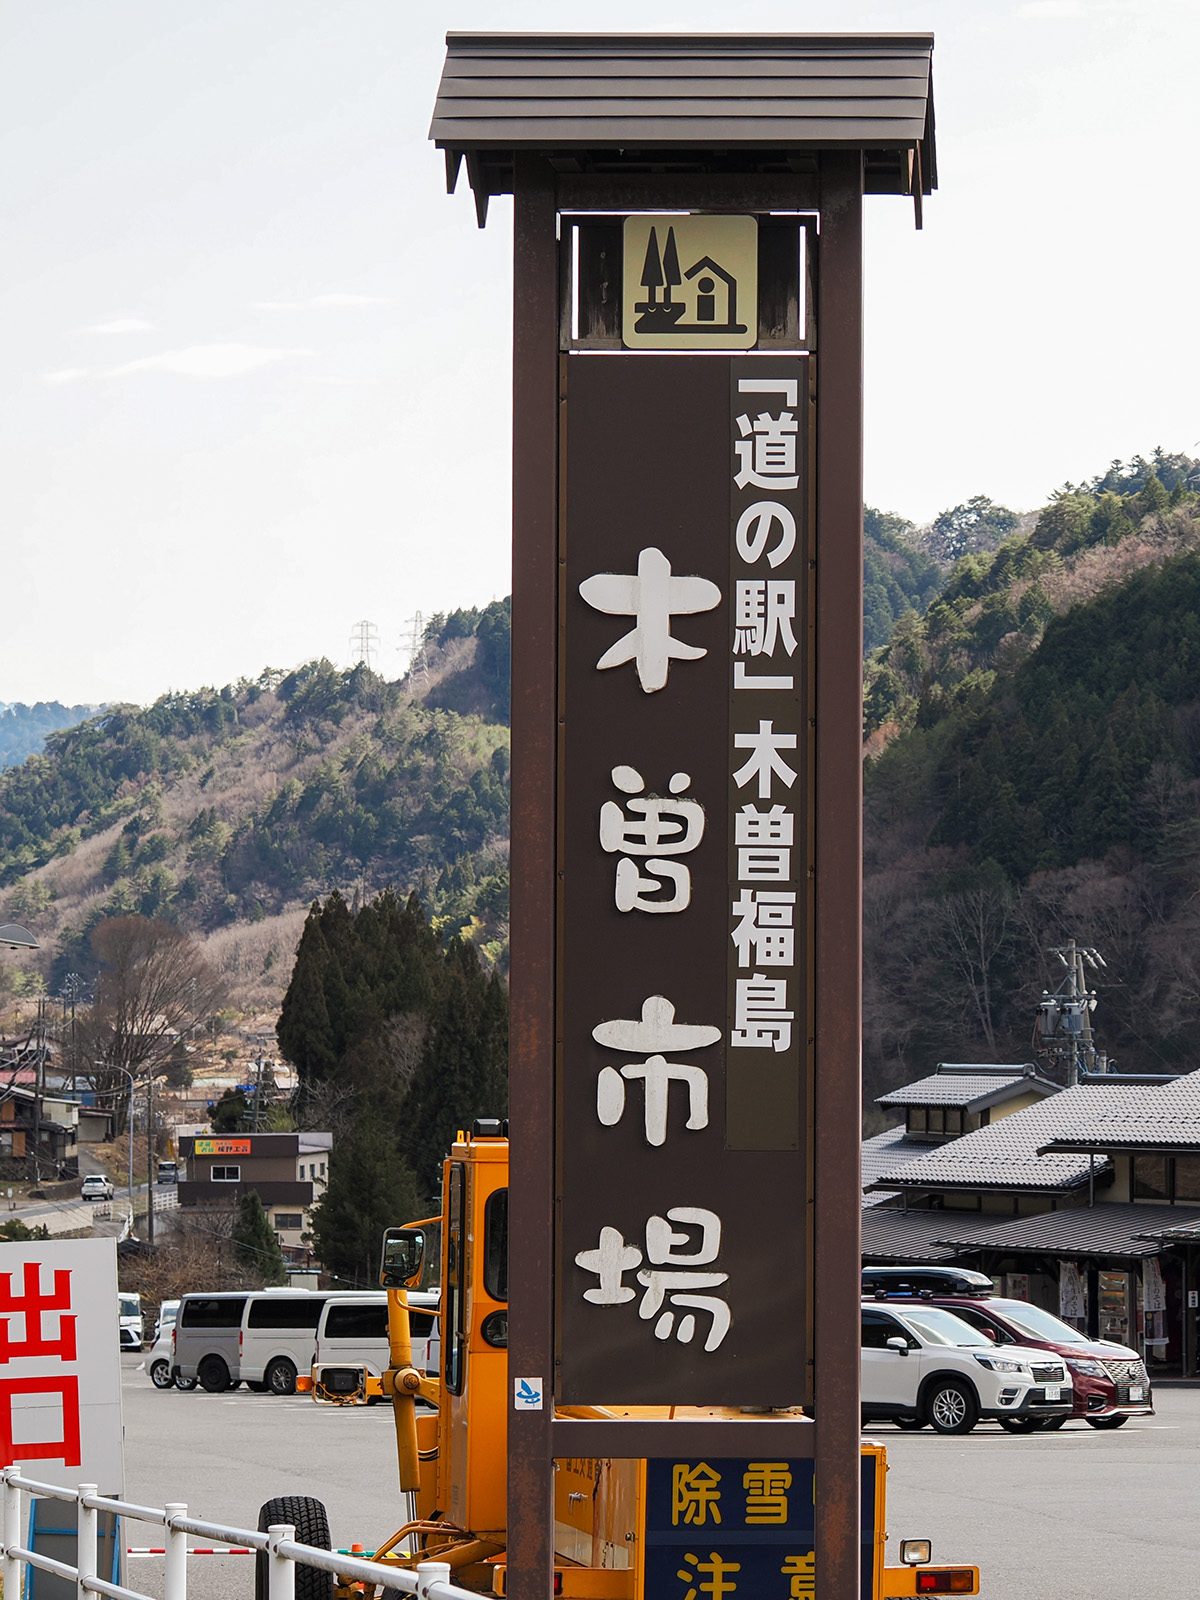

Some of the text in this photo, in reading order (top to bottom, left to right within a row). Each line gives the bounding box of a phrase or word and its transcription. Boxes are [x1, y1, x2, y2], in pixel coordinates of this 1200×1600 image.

[575, 547, 732, 1352] 木曽市場
[0, 1262, 81, 1470] 出口
[671, 1461, 815, 1526] 除雪
